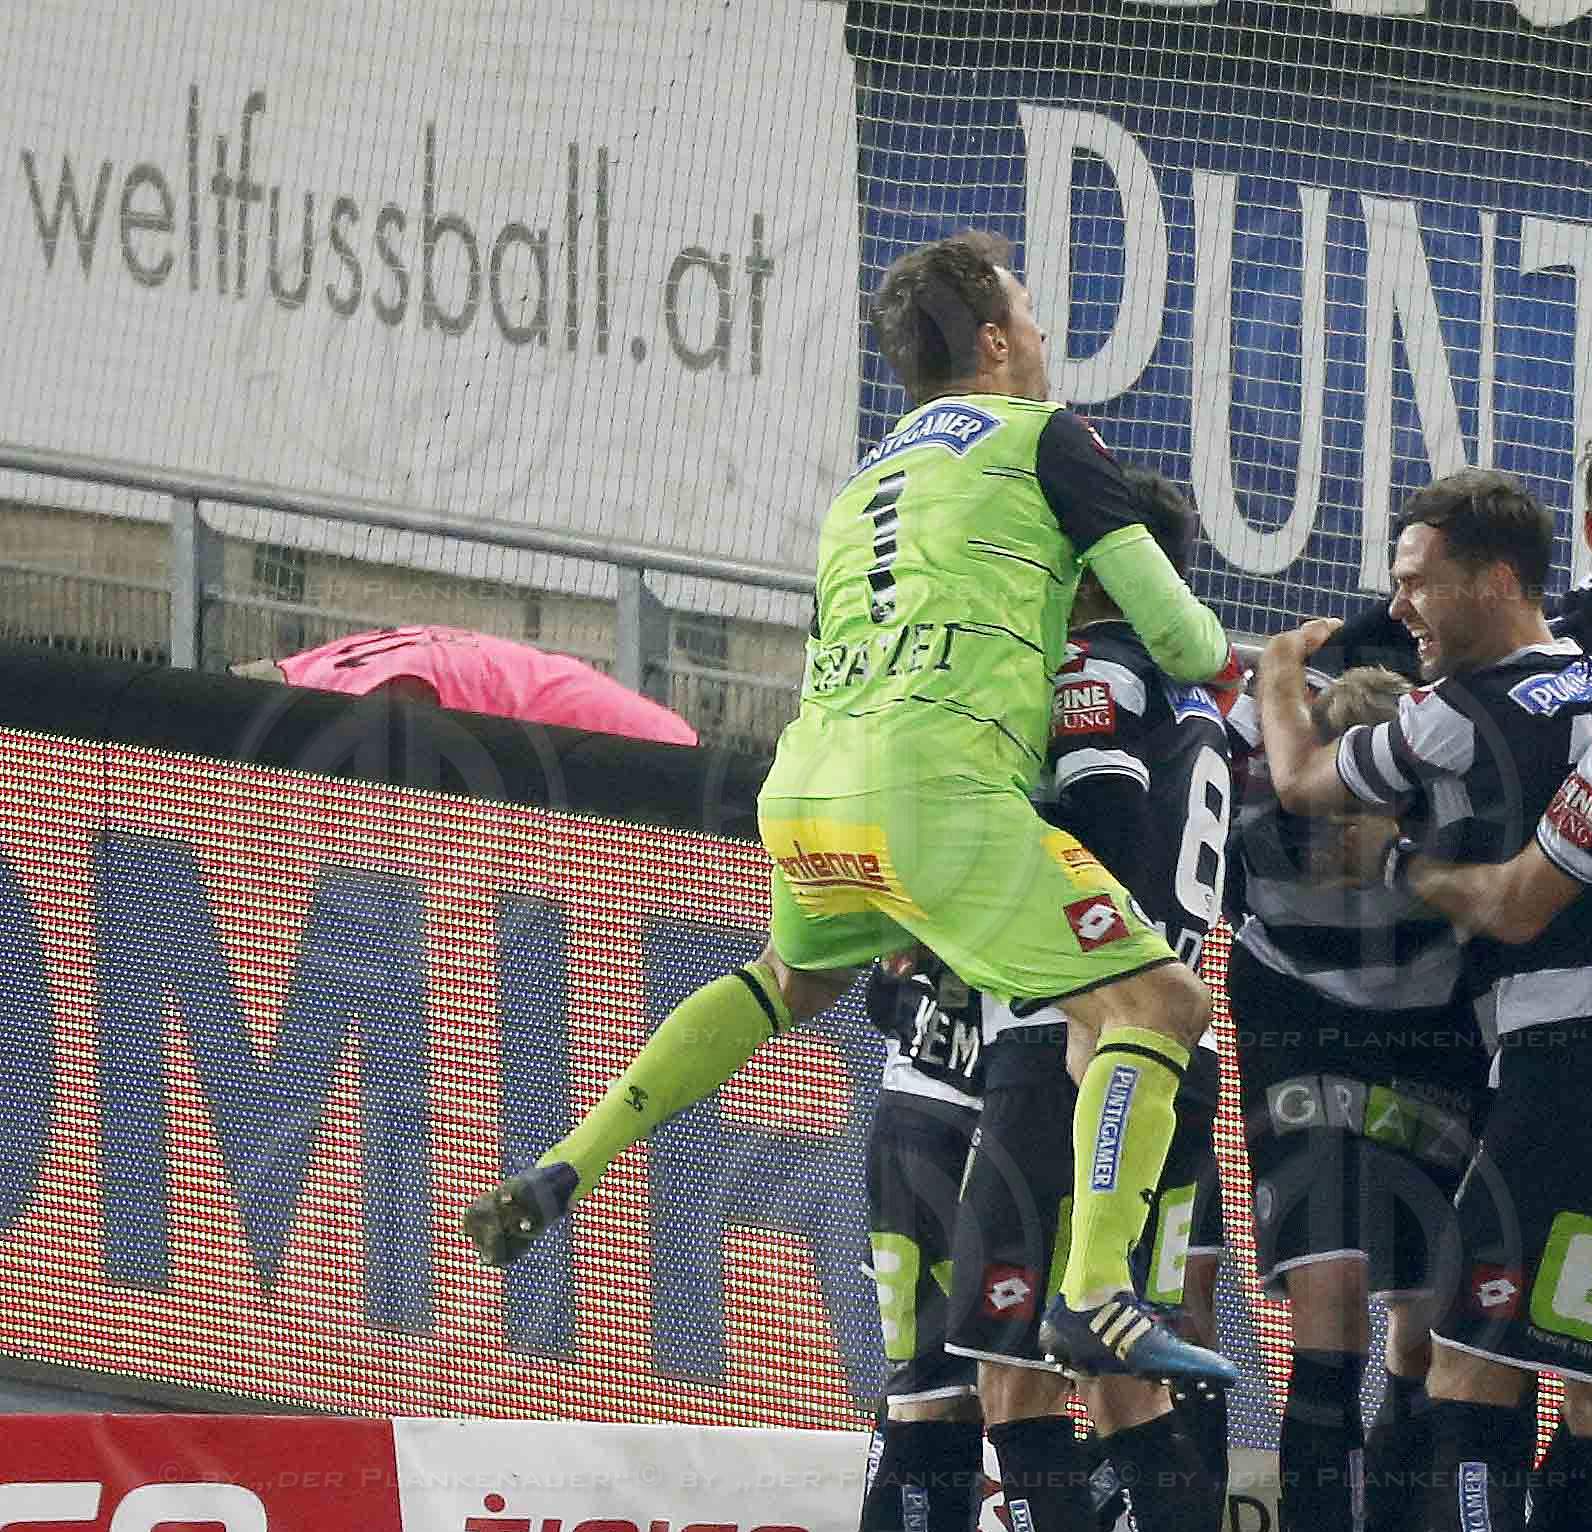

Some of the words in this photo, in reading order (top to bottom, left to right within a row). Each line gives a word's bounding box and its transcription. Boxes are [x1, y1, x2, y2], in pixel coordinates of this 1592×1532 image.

[20, 84, 776, 376] weltfussball.at
[858, 470, 905, 624] 1
[1176, 745, 1231, 927] 8
[1092, 1068, 1138, 1190] PUNTIGAMER
